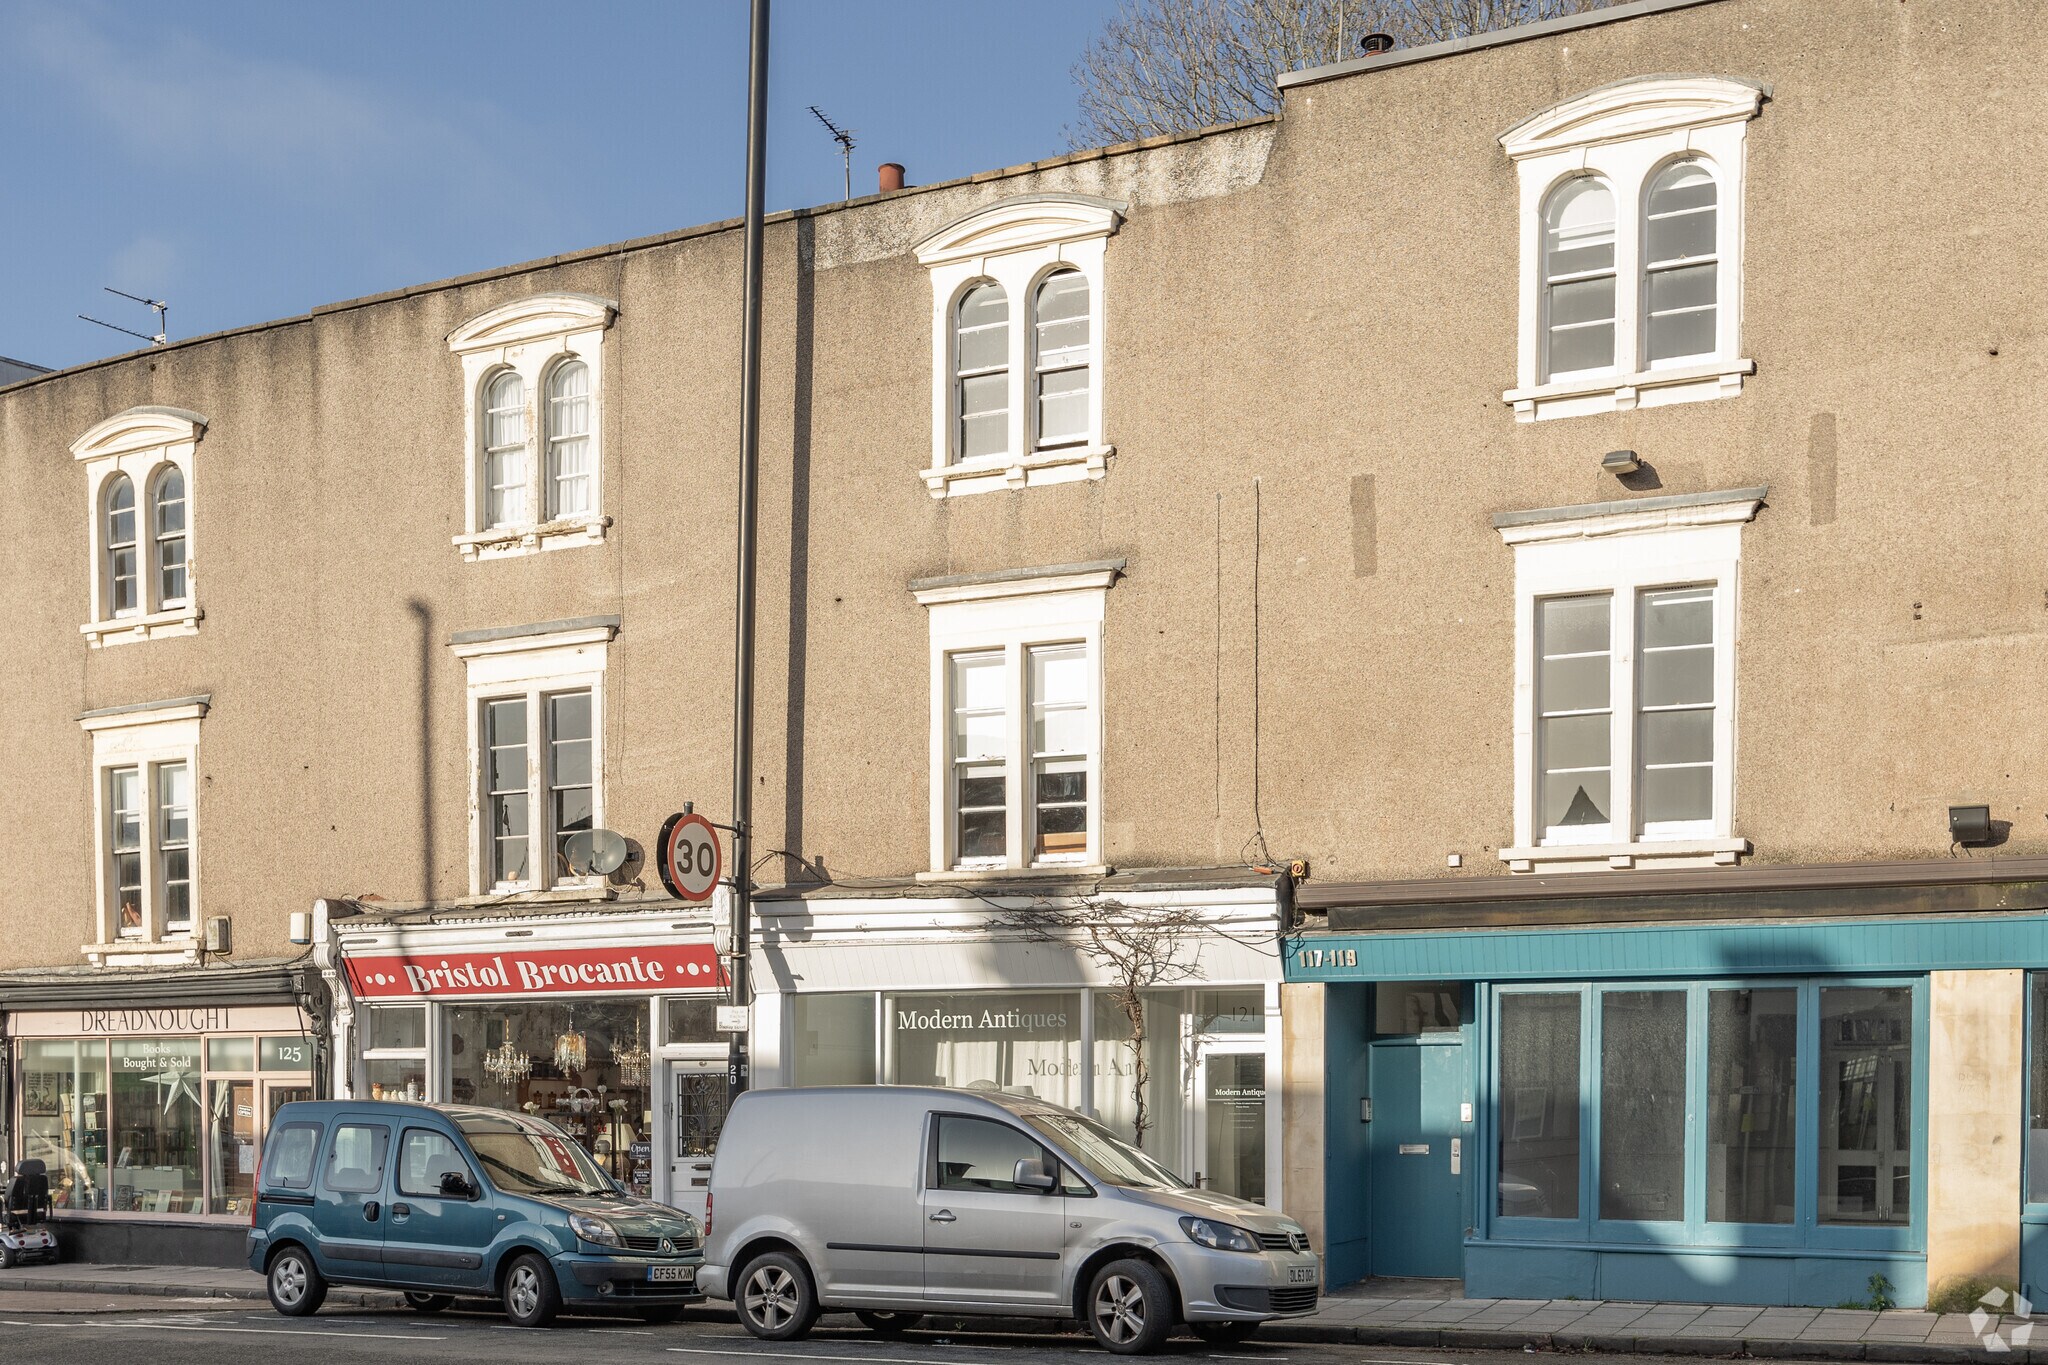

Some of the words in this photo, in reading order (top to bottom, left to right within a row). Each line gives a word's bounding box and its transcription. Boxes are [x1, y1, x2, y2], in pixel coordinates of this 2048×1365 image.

[677, 839, 714, 877] 30
[1297, 949, 1358, 968] 117-119
[403, 956, 511, 993] Bristol
[515, 955, 665, 991] Brocante
[81, 1007, 231, 1032] DREADNOUGHT
[897, 1009, 974, 1030] Modern
[977, 1007, 1067, 1033] Antiques
[1232, 1006, 1255, 1022] 121
[143, 1043, 171, 1054] Books
[278, 1046, 302, 1063] 125
[123, 1057, 156, 1071] Bought
[160, 1058, 167, 1068] &
[171, 1057, 191, 1068] Sold
[1027, 1056, 1101, 1077] Moden
[1214, 1088, 1241, 1096] Modern
[631, 1143, 651, 1154] Open
[653, 1267, 676, 1280] CF55
